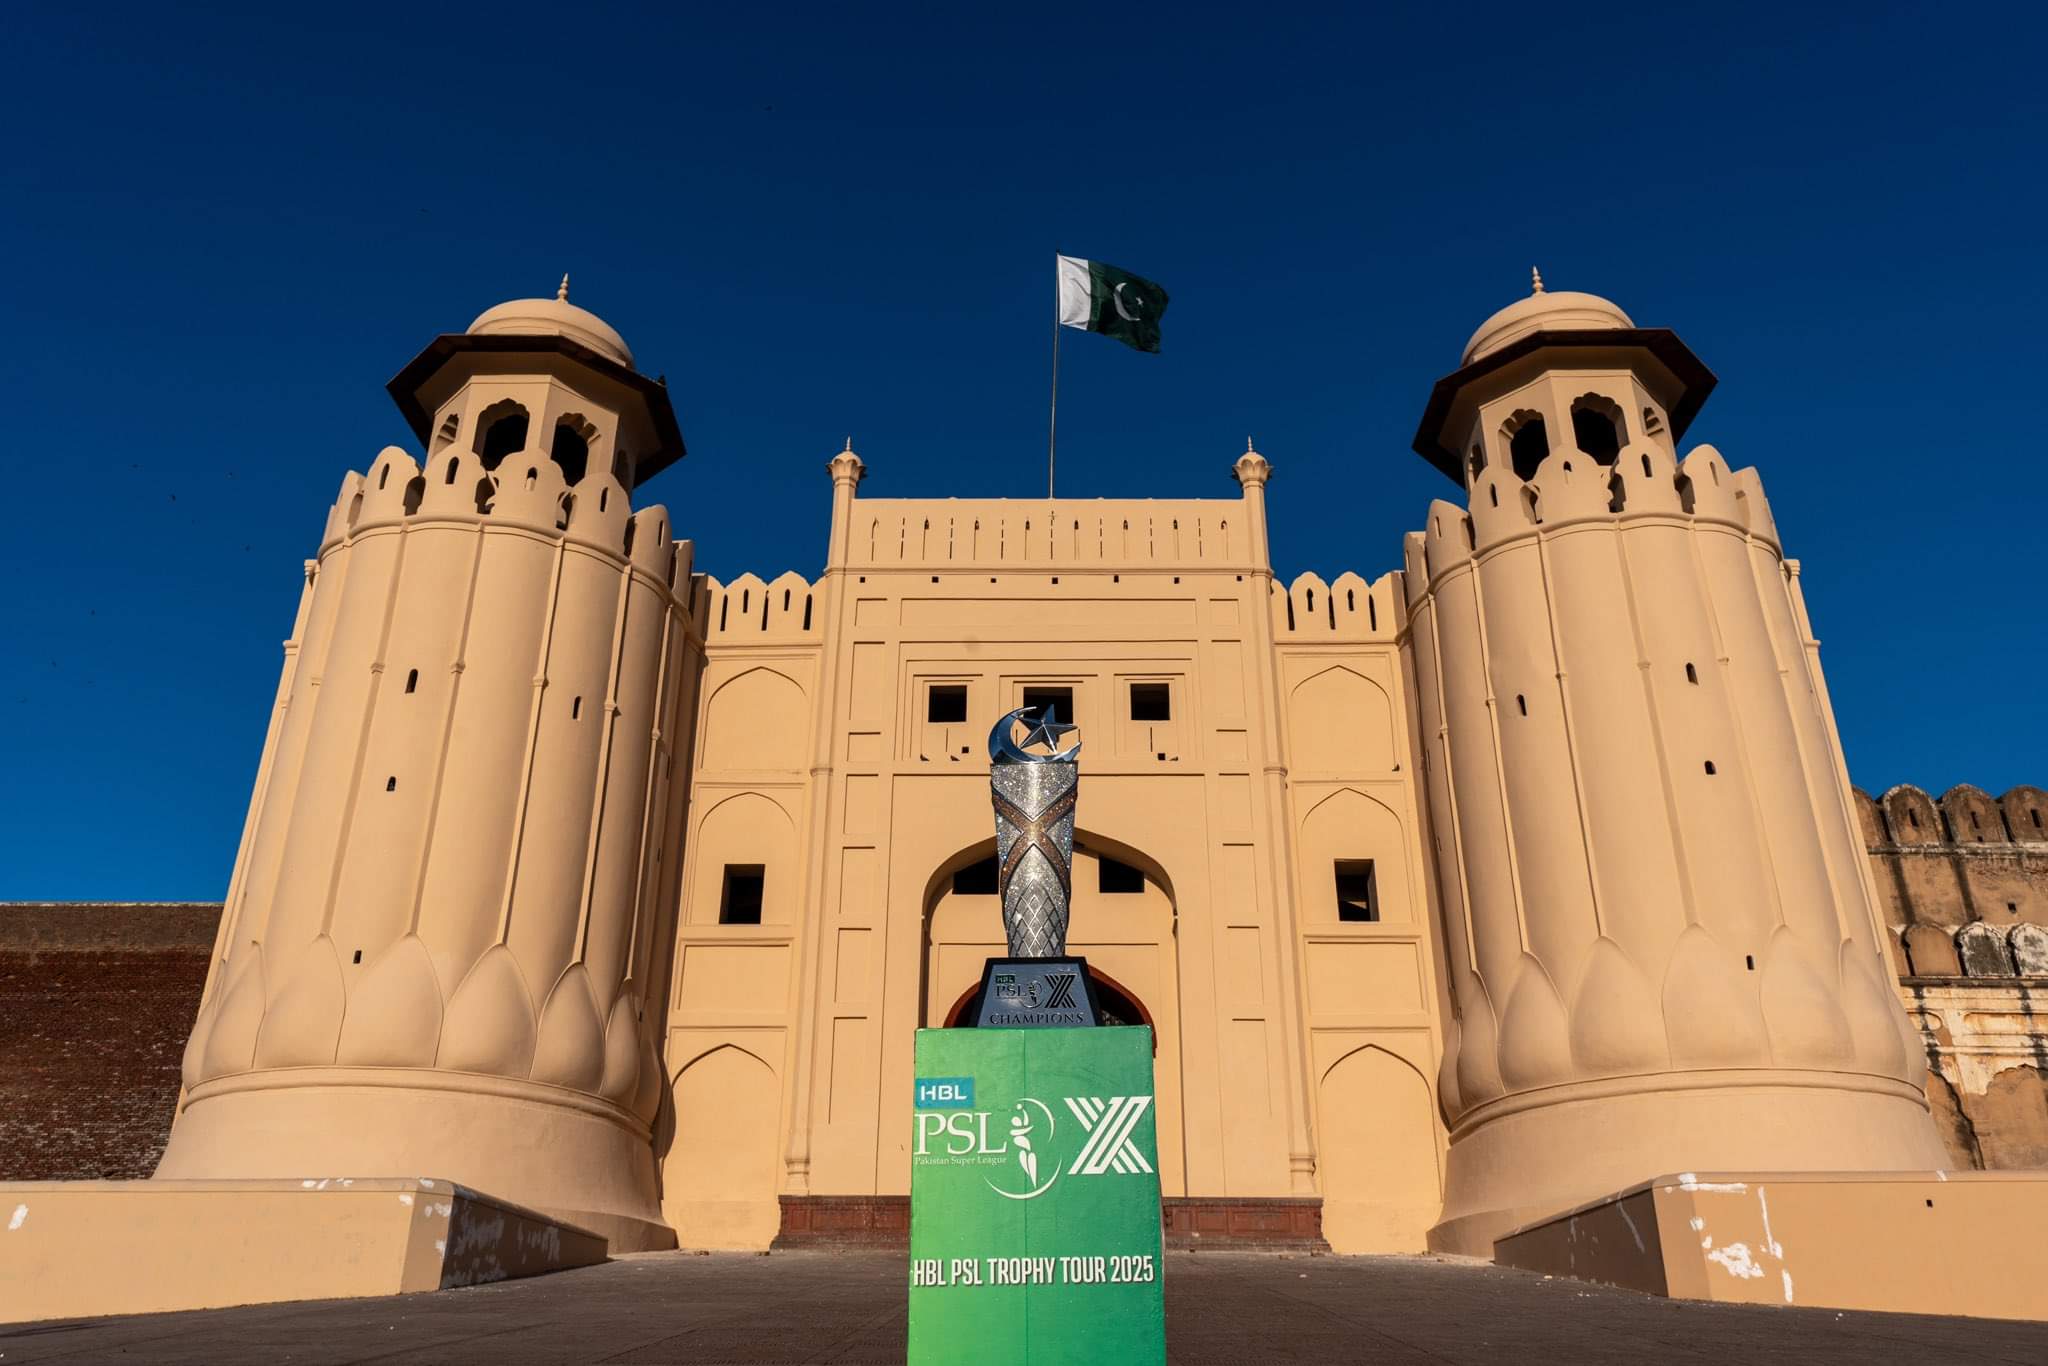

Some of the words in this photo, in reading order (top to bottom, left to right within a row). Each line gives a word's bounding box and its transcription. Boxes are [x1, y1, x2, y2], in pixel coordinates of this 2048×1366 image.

[995, 984, 1027, 997] PSL
[989, 1012, 1084, 1025] CHAMPIONS
[920, 1085, 967, 1101] HBL
[914, 1112, 1008, 1155] PSL
[1063, 1096, 1154, 1175] X
[914, 1156, 949, 1165] Pakistan
[951, 1156, 975, 1167] Super
[977, 1156, 1008, 1167] League
[913, 1260, 946, 1286] HBL
[951, 1259, 983, 1286] PSL
[987, 1257, 1056, 1285] TROPHY
[1060, 1256, 1107, 1284] TOUR
[1110, 1255, 1154, 1283] 2025
